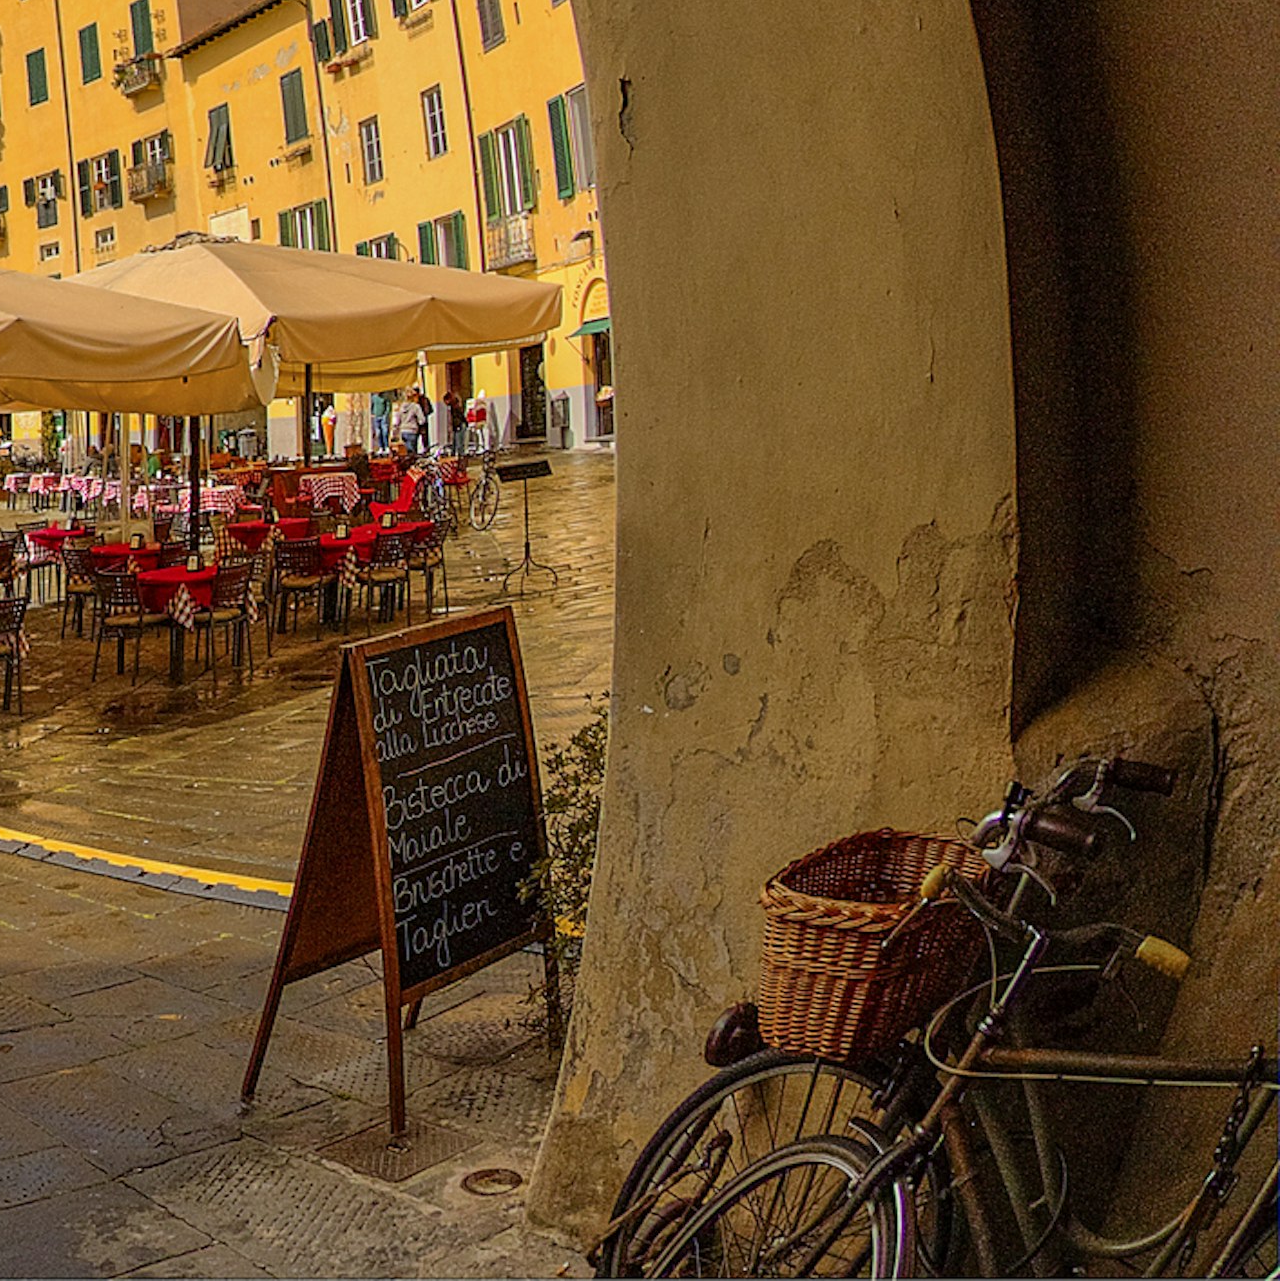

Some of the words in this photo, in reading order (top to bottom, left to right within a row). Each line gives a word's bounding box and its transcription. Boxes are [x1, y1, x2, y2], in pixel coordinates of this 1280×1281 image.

[365, 641, 488, 717] Tagliata
[373, 696, 403, 733] di
[420, 665, 513, 724] Entrecote
[375, 728, 418, 762] alla
[421, 710, 499, 748] Lucchese
[382, 771, 491, 830] Bistecca
[498, 743, 527, 787] di
[388, 807, 472, 868] Maiale
[393, 845, 501, 912] Bruschette
[509, 841, 527, 862] e
